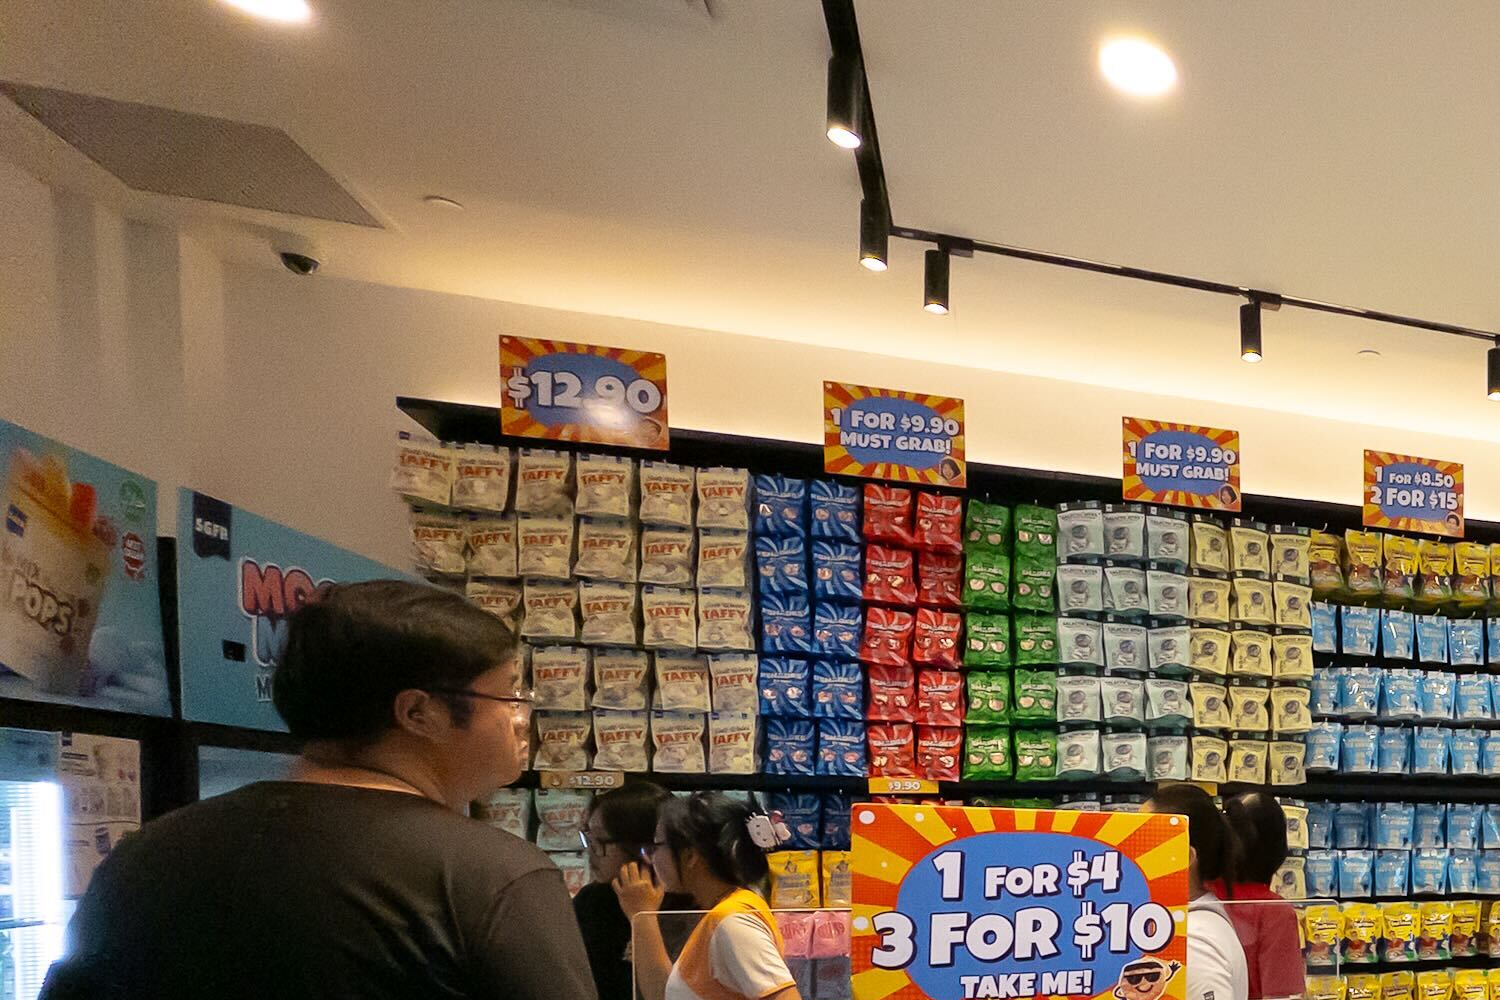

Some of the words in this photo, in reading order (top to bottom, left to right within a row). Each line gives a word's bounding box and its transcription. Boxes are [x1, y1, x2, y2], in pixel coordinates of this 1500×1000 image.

[831, 408, 842, 426] 1
[850, 410, 895, 431] FOR
[900, 413, 960, 436] $9.90
[840, 431, 892, 449] MUST
[895, 435, 952, 455] GRAB!
[1127, 441, 1137, 458] 1
[1144, 442, 1182, 460] FOR
[1186, 445, 1236, 465] $9.90
[581, 475, 626, 486] TAFFY
[1136, 462, 1179, 477] MUST
[1182, 466, 1229, 481] GRAB!
[1374, 466, 1383, 482] 1
[1389, 473, 1412, 485] FOR
[1414, 471, 1455, 488] $8.50
[643, 482, 690, 495] TAFFY
[700, 486, 744, 498] TAFFY
[1370, 485, 1382, 504] 2
[1386, 487, 1425, 507] FOR
[1429, 490, 1458, 510] $15
[241, 558, 338, 616] MO
[646, 606, 691, 619] TAFFY
[701, 609, 746, 620] TAFFY
[535, 667, 581, 681] TAFFY
[933, 850, 964, 900] 1
[985, 864, 1059, 898] FOR
[1067, 849, 1121, 897] $4
[871, 911, 917, 970] 3
[928, 906, 1060, 966] FOR
[1073, 901, 1175, 961] $10
[960, 972, 1036, 1000] TAKE
[1042, 970, 1093, 996] ME!
